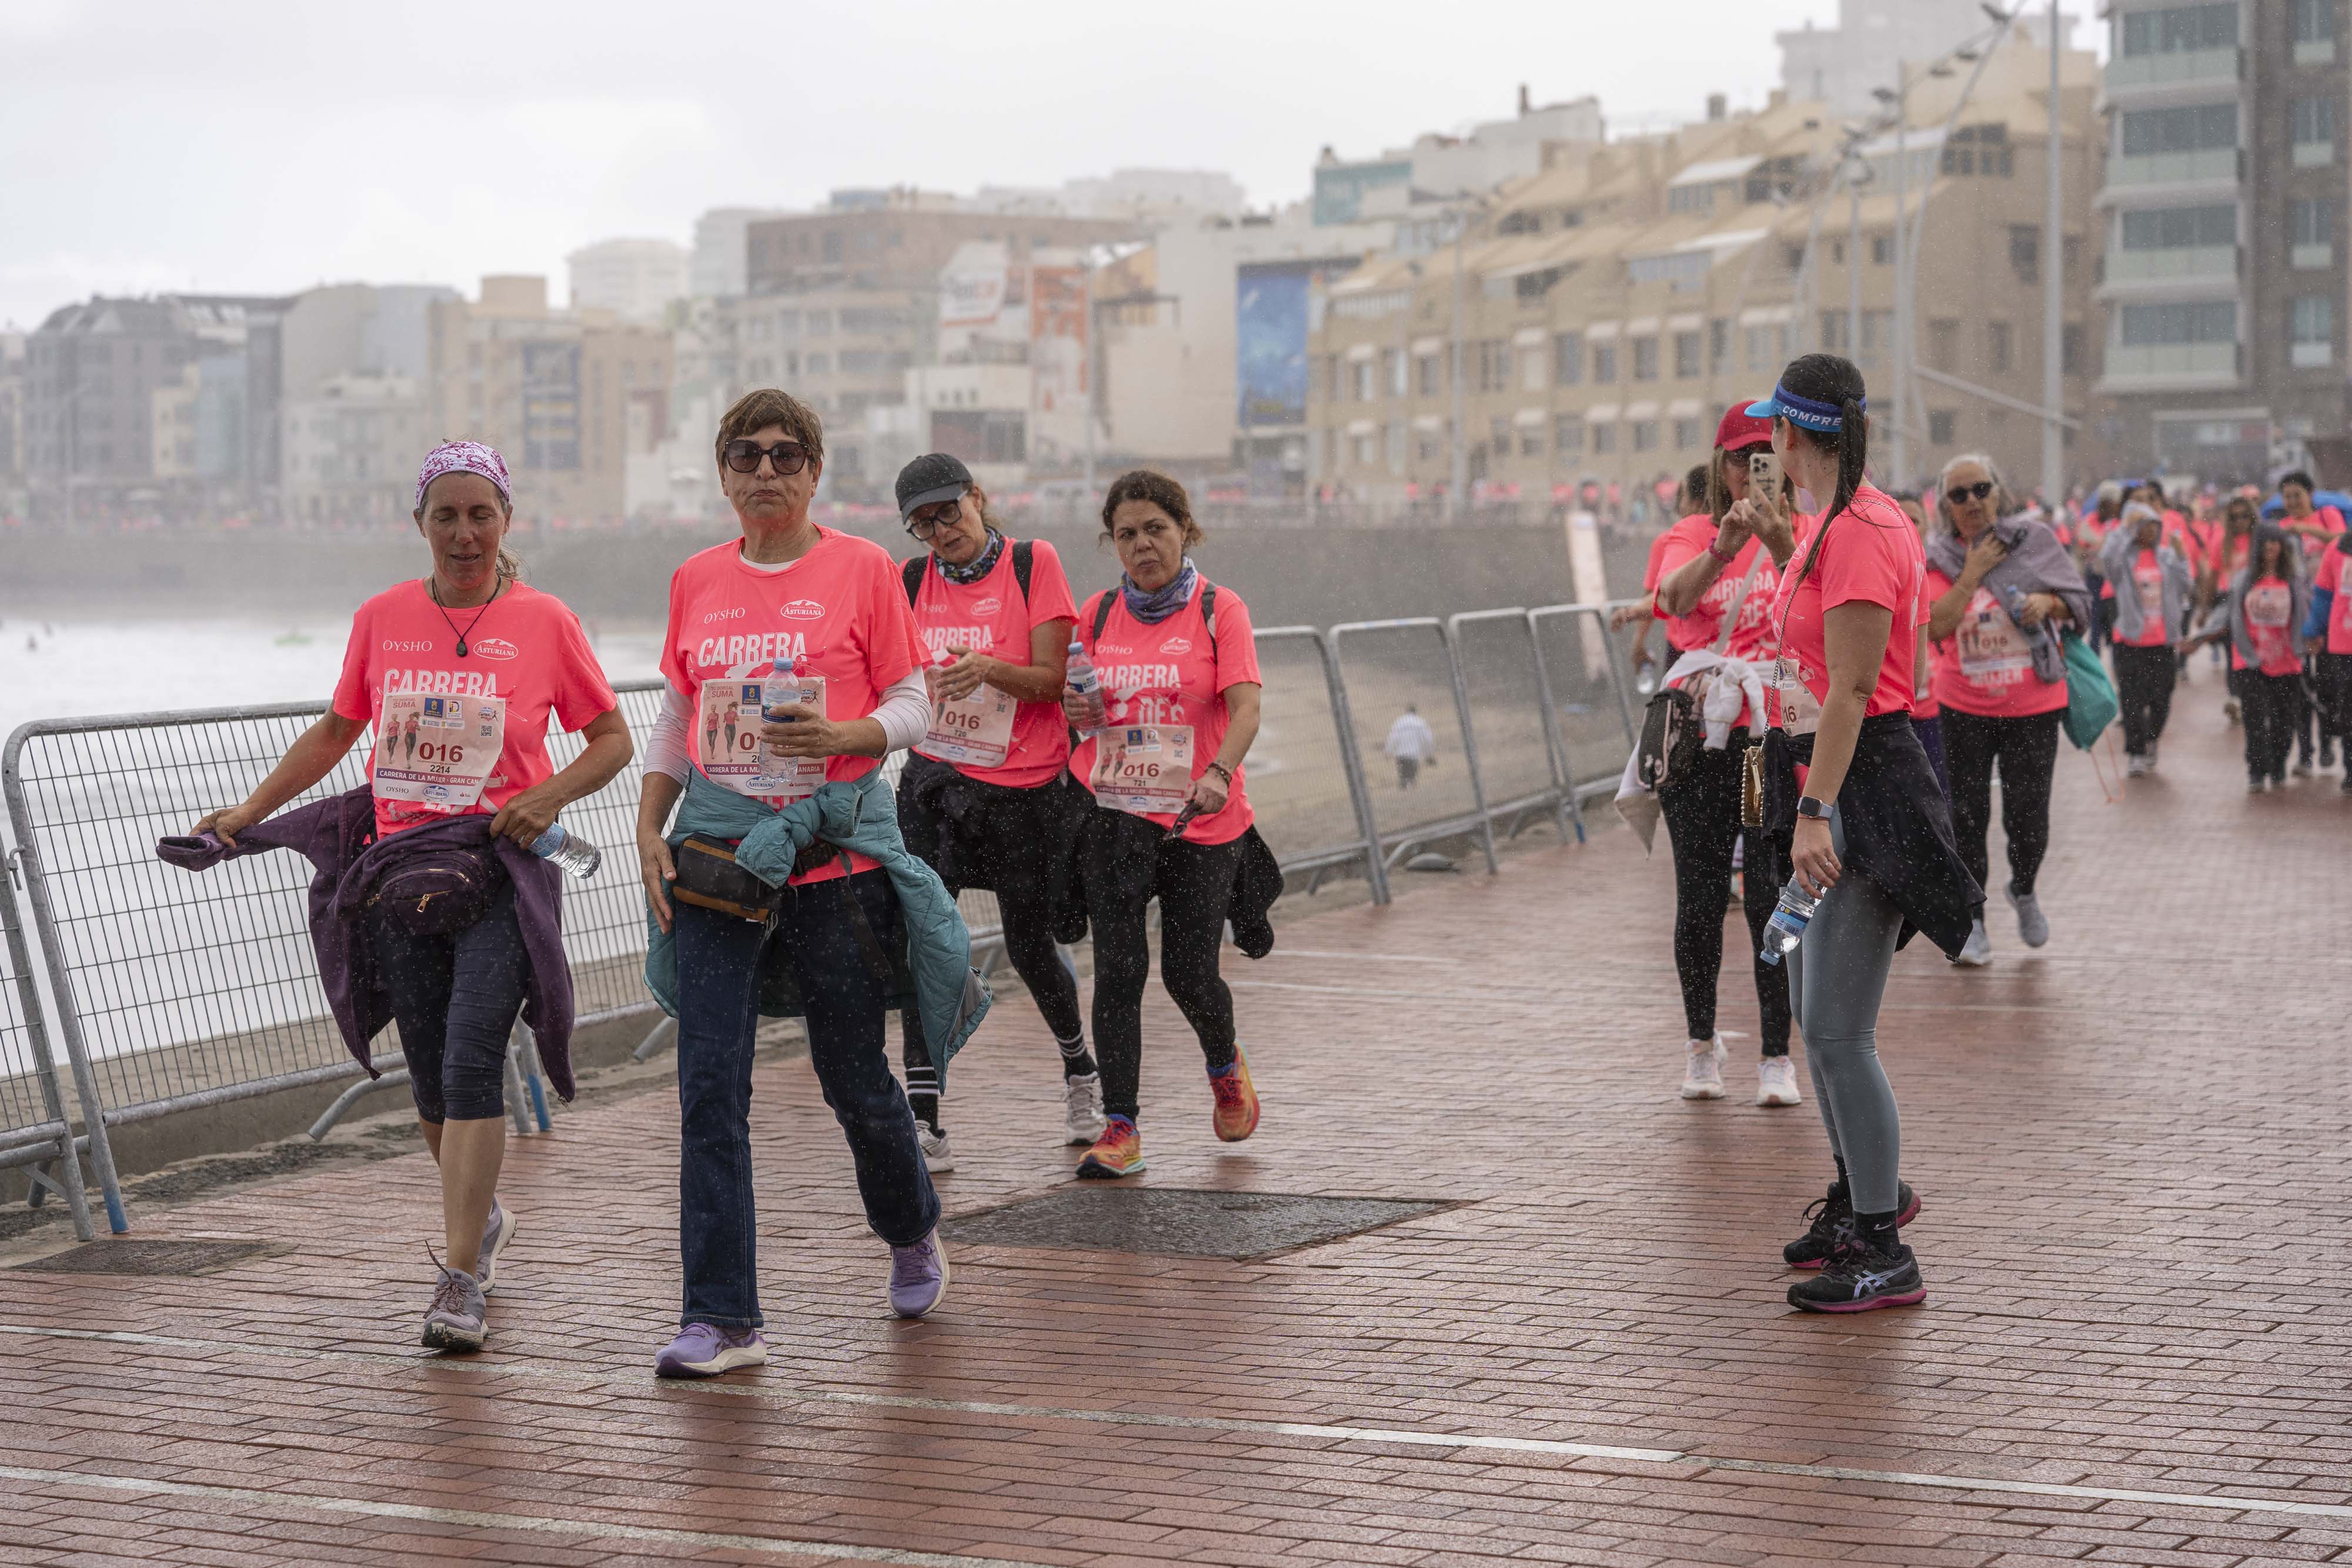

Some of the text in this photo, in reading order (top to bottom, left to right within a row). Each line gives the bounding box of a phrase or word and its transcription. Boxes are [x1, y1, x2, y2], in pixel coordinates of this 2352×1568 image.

[704, 607, 746, 624] OYSHO
[784, 606, 821, 616] ASTURIANA
[923, 624, 994, 650] ARRERA
[383, 640, 432, 652] OYSHO
[697, 631, 807, 667] CARRERA
[383, 668, 497, 698] CARRERA
[1095, 664, 1181, 689] CARRERA
[946, 711, 981, 730] 016
[1782, 706, 1797, 724] 16
[954, 729, 967, 737] 720
[419, 742, 463, 763] 016
[379, 770, 407, 779] CARRERA
[430, 764, 450, 774] 2214
[1124, 763, 1159, 777] 016
